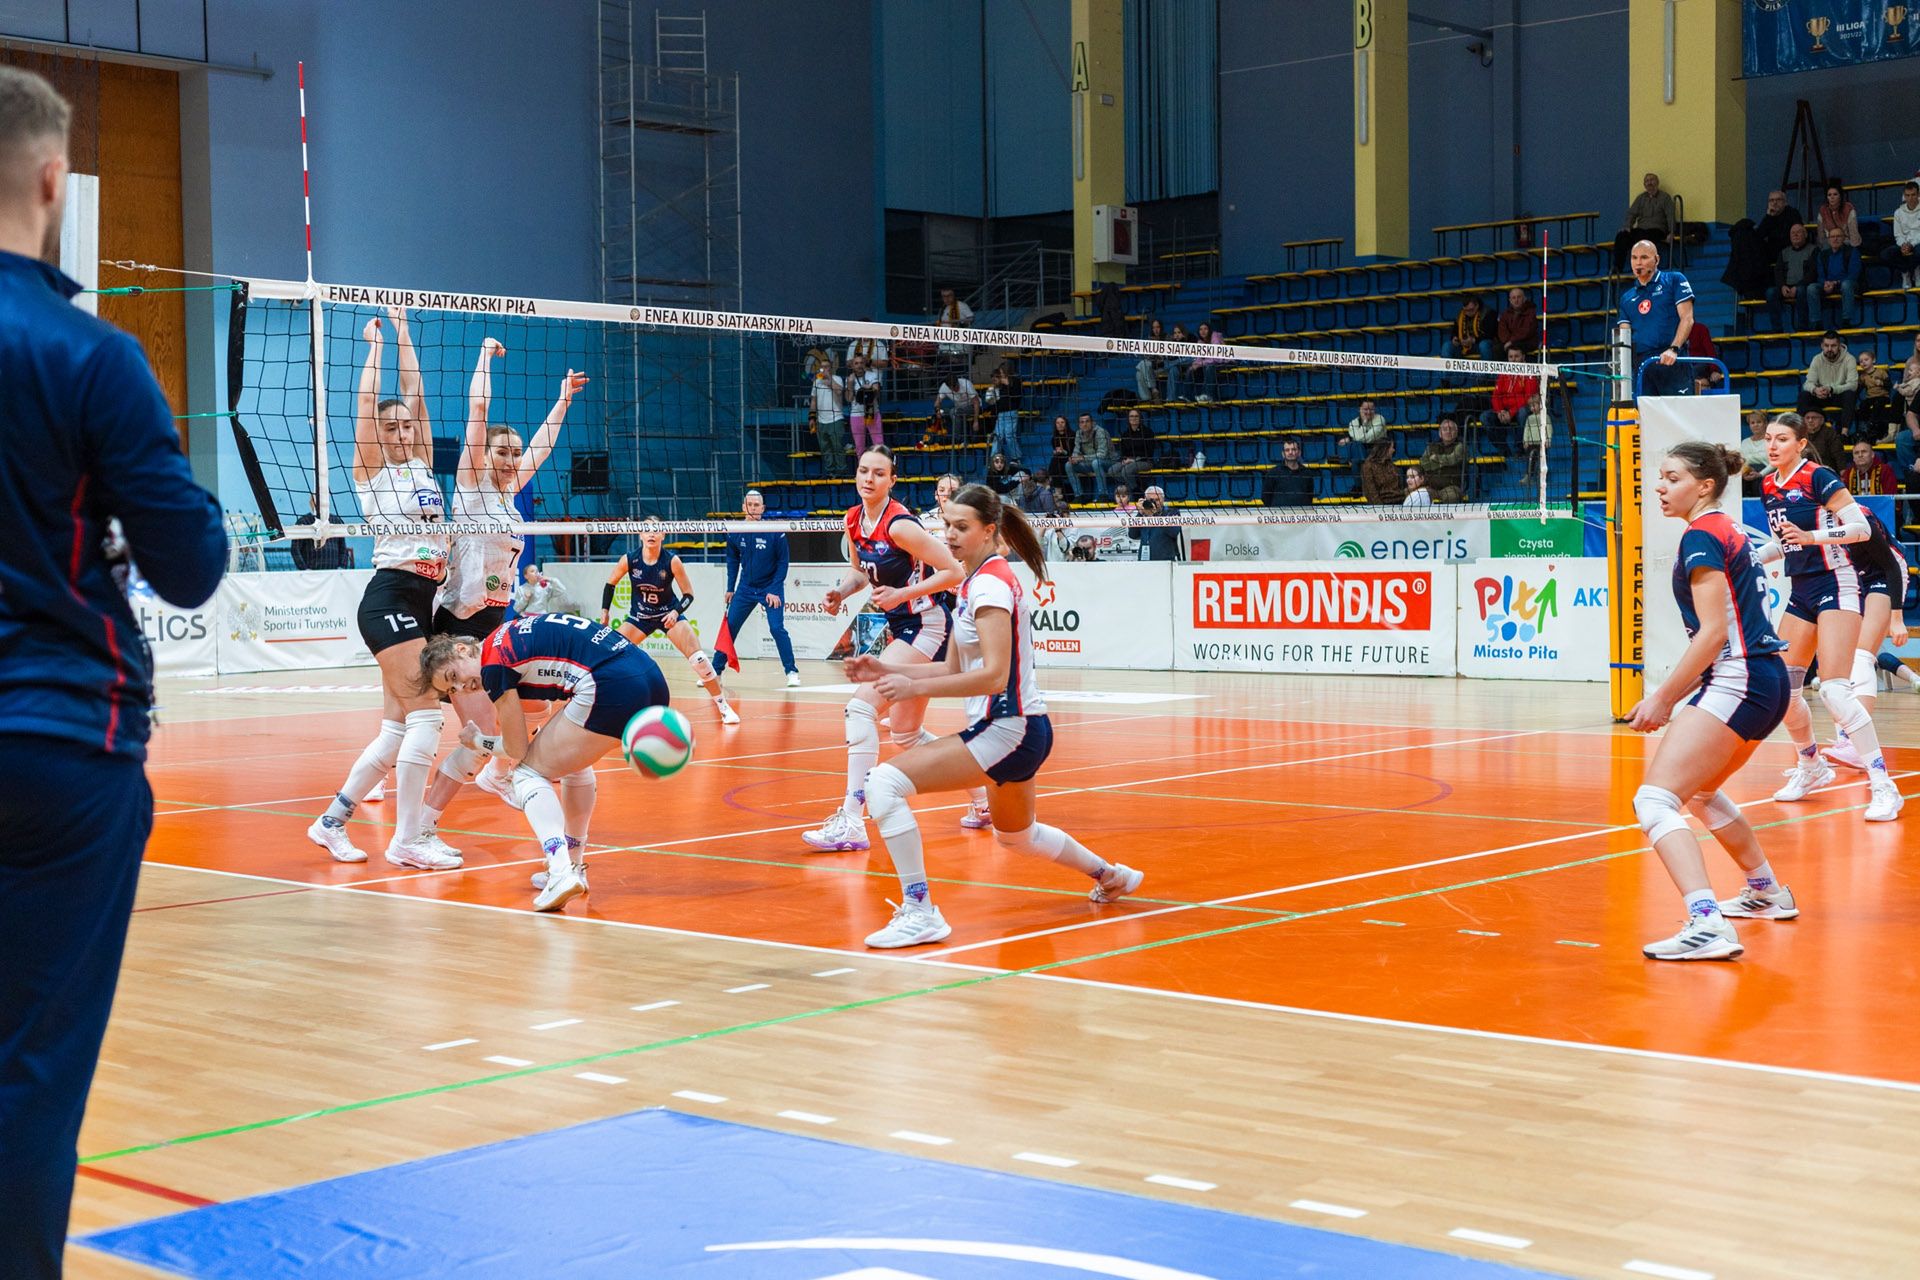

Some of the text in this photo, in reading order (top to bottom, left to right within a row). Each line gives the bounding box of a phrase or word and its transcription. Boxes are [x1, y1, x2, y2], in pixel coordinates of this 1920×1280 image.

[1354, 0, 1372, 48] B
[1846, 22, 1866, 30] LIGA
[1840, 32, 1863, 40] 2021/22
[1072, 42, 1089, 92] A
[330, 286, 536, 314] ENEA KLUB SIATKARSKI PIŁA
[645, 309, 814, 333] ENEA KLUB SIATKARSKI PIŁA
[903, 326, 1042, 346] ENEA KLUB SIATKARSKI PIŁA
[1117, 340, 1234, 358] ENEA KLUB SIATKARSKI PIŁA
[1298, 351, 1398, 366] ENEA KLUB SIATKARSKI PIŁA
[1452, 360, 1540, 374] ENEA KLUB SIATKARSKI PIŁA
[1029, 518, 1074, 527] TKARSKI PIŁA
[1128, 516, 1216, 526] ENEA KLUB SIATKARSKI PIŁA
[1384, 512, 1454, 521] ENEA KLUB SIATKARSKI PIŁA
[360, 523, 513, 536] ENEA KLUB SIATKARSKI PIŁA
[596, 522, 728, 533] ENEA KLUB SIATKARSKI PIŁA
[800, 520, 823, 530] ENEA
[1225, 544, 1260, 556] Polska
[1371, 531, 1468, 560] eneris
[1518, 538, 1554, 550] Czysta
[509, 548, 520, 568] 7
[641, 592, 659, 604] 18
[264, 606, 327, 616] Ministerstwo
[784, 602, 816, 613] POLSKA
[140, 607, 207, 642] tics
[264, 620, 296, 632] Sportu
[304, 618, 347, 631] Turystyki
[384, 612, 418, 633] 15
[545, 614, 592, 630] 5
[1030, 610, 1080, 632] XALO
[1486, 614, 1536, 642] 500
[1034, 640, 1078, 650] PA ORLEN
[1474, 645, 1558, 659] Miasto Piła
[1194, 643, 1430, 664] WORKING FOR THE FUTURE
[538, 668, 562, 678] ENEA
